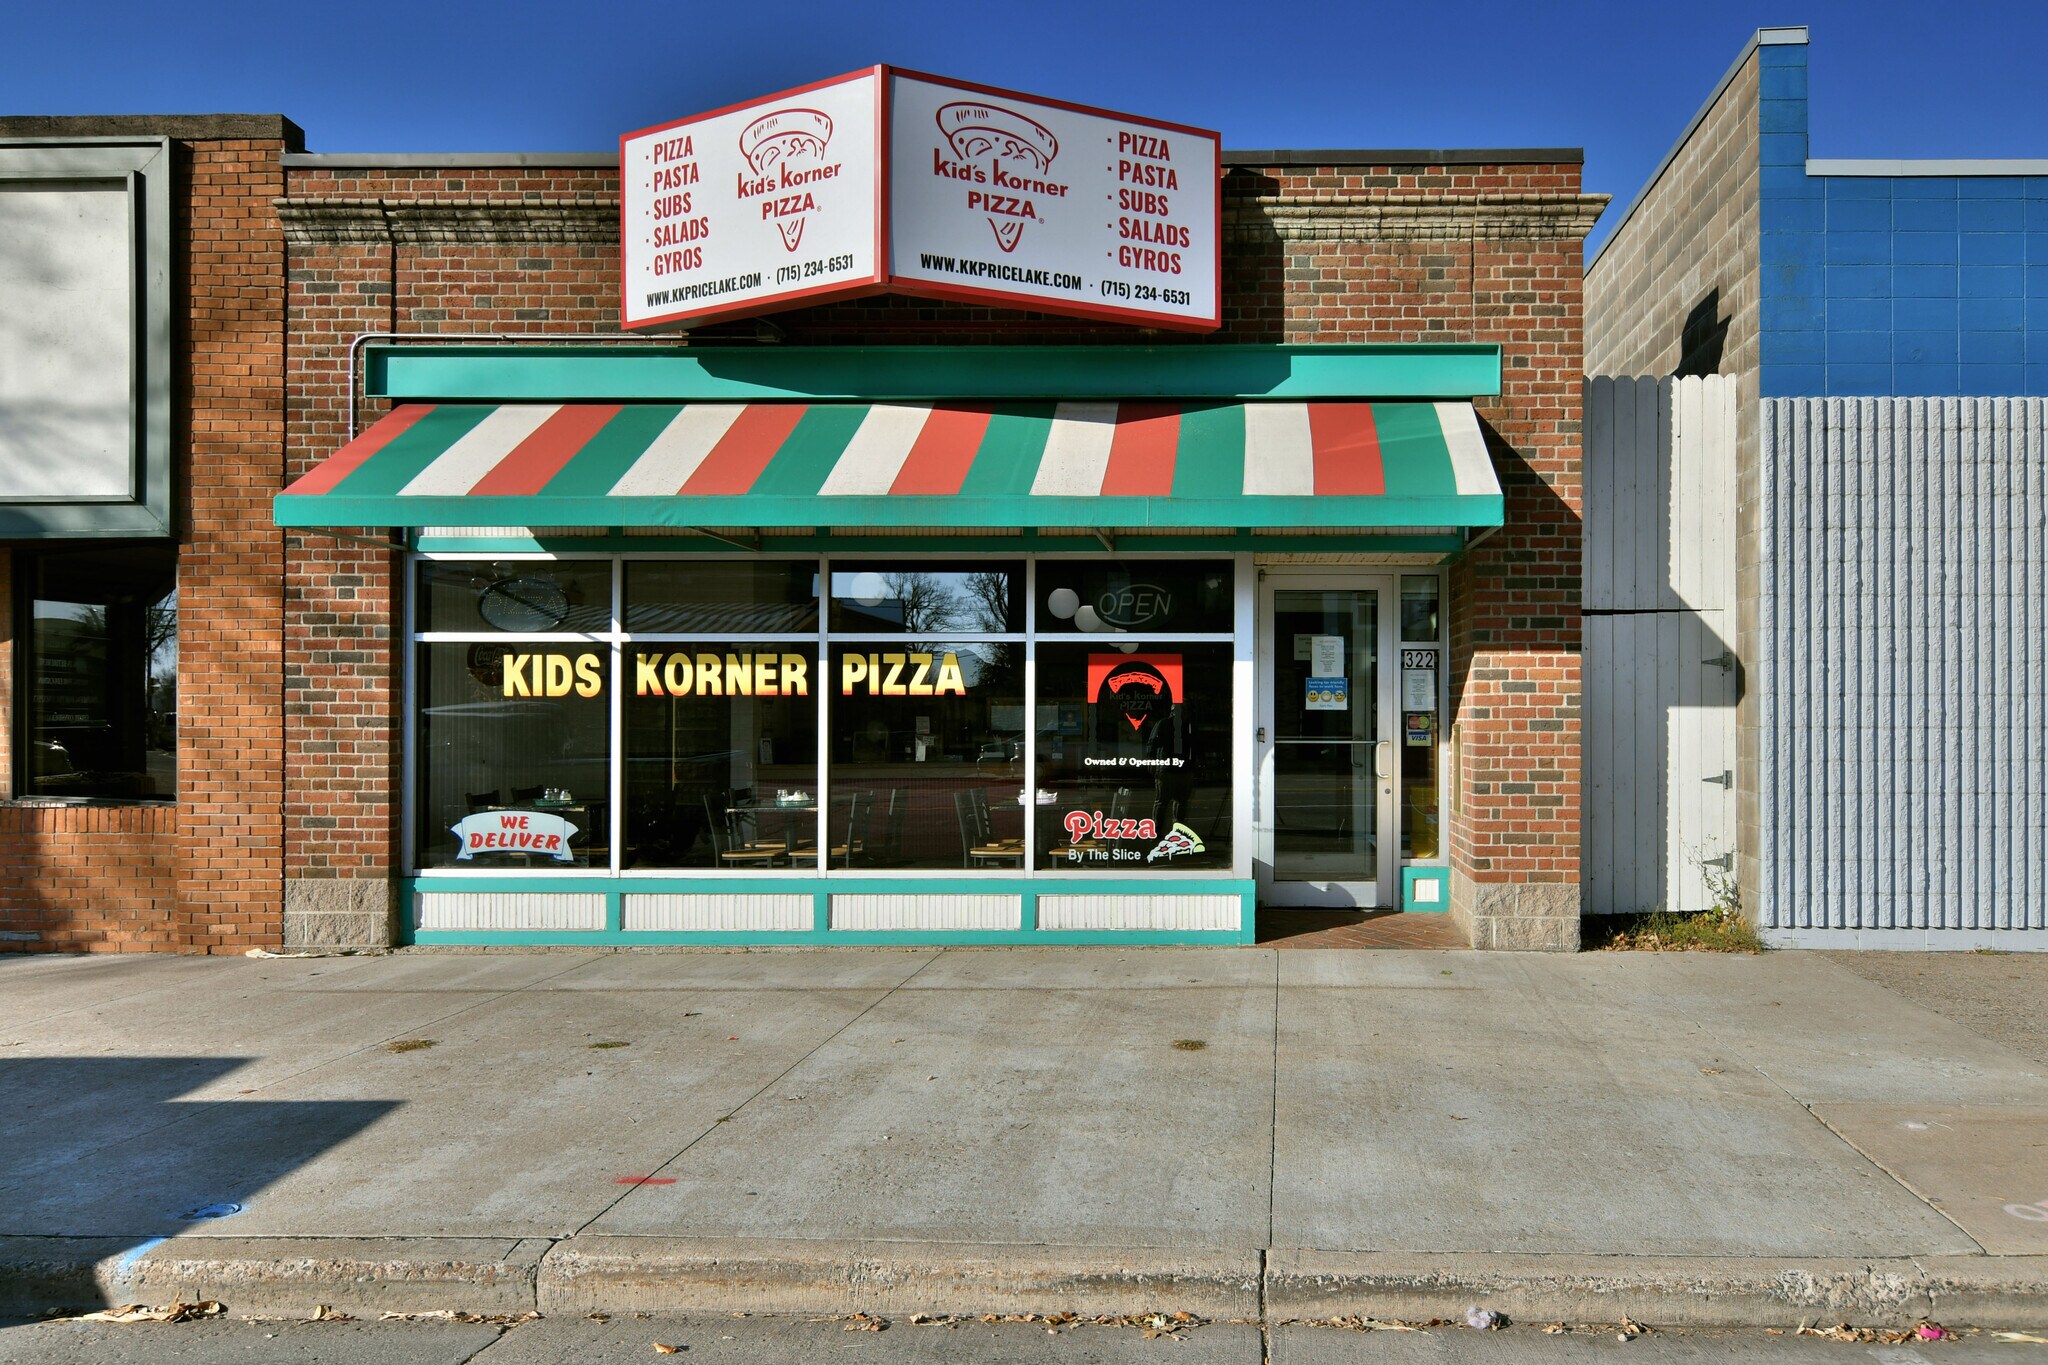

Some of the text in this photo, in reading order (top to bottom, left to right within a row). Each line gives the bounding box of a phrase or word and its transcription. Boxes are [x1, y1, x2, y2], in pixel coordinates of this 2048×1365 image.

[653, 135, 694, 165] PIZZA
[1118, 131, 1171, 162] PIZZA
[653, 162, 699, 193] PASTA
[1118, 159, 1178, 190] PASTA
[653, 192, 692, 221] SUBS
[762, 192, 815, 220] PIZZA
[968, 190, 1036, 220] PIZZA
[1118, 188, 1169, 217] SUBS
[653, 216, 709, 249] SALADS
[1118, 217, 1191, 248] SALADS
[654, 246, 703, 277] GYROS
[1118, 245, 1182, 275] GYROS
[646, 253, 854, 308] WWW.KKPRICELAKE.COM (715) 234-6531
[920, 253, 1191, 306] WWW.KKPRICELAKE.COM (715) 234-6531
[1100, 592, 1171, 616] OPEN
[503, 652, 967, 698] KIDS KORNER PIZZA
[1406, 652, 1434, 668] 322
[1120, 701, 1153, 710] PIZZA
[1084, 757, 1185, 768] Owned & Operated By
[500, 815, 530, 829] WE
[1064, 810, 1157, 844] Pizza
[469, 832, 561, 851] DELIVER
[1068, 848, 1141, 863] By The Slice
